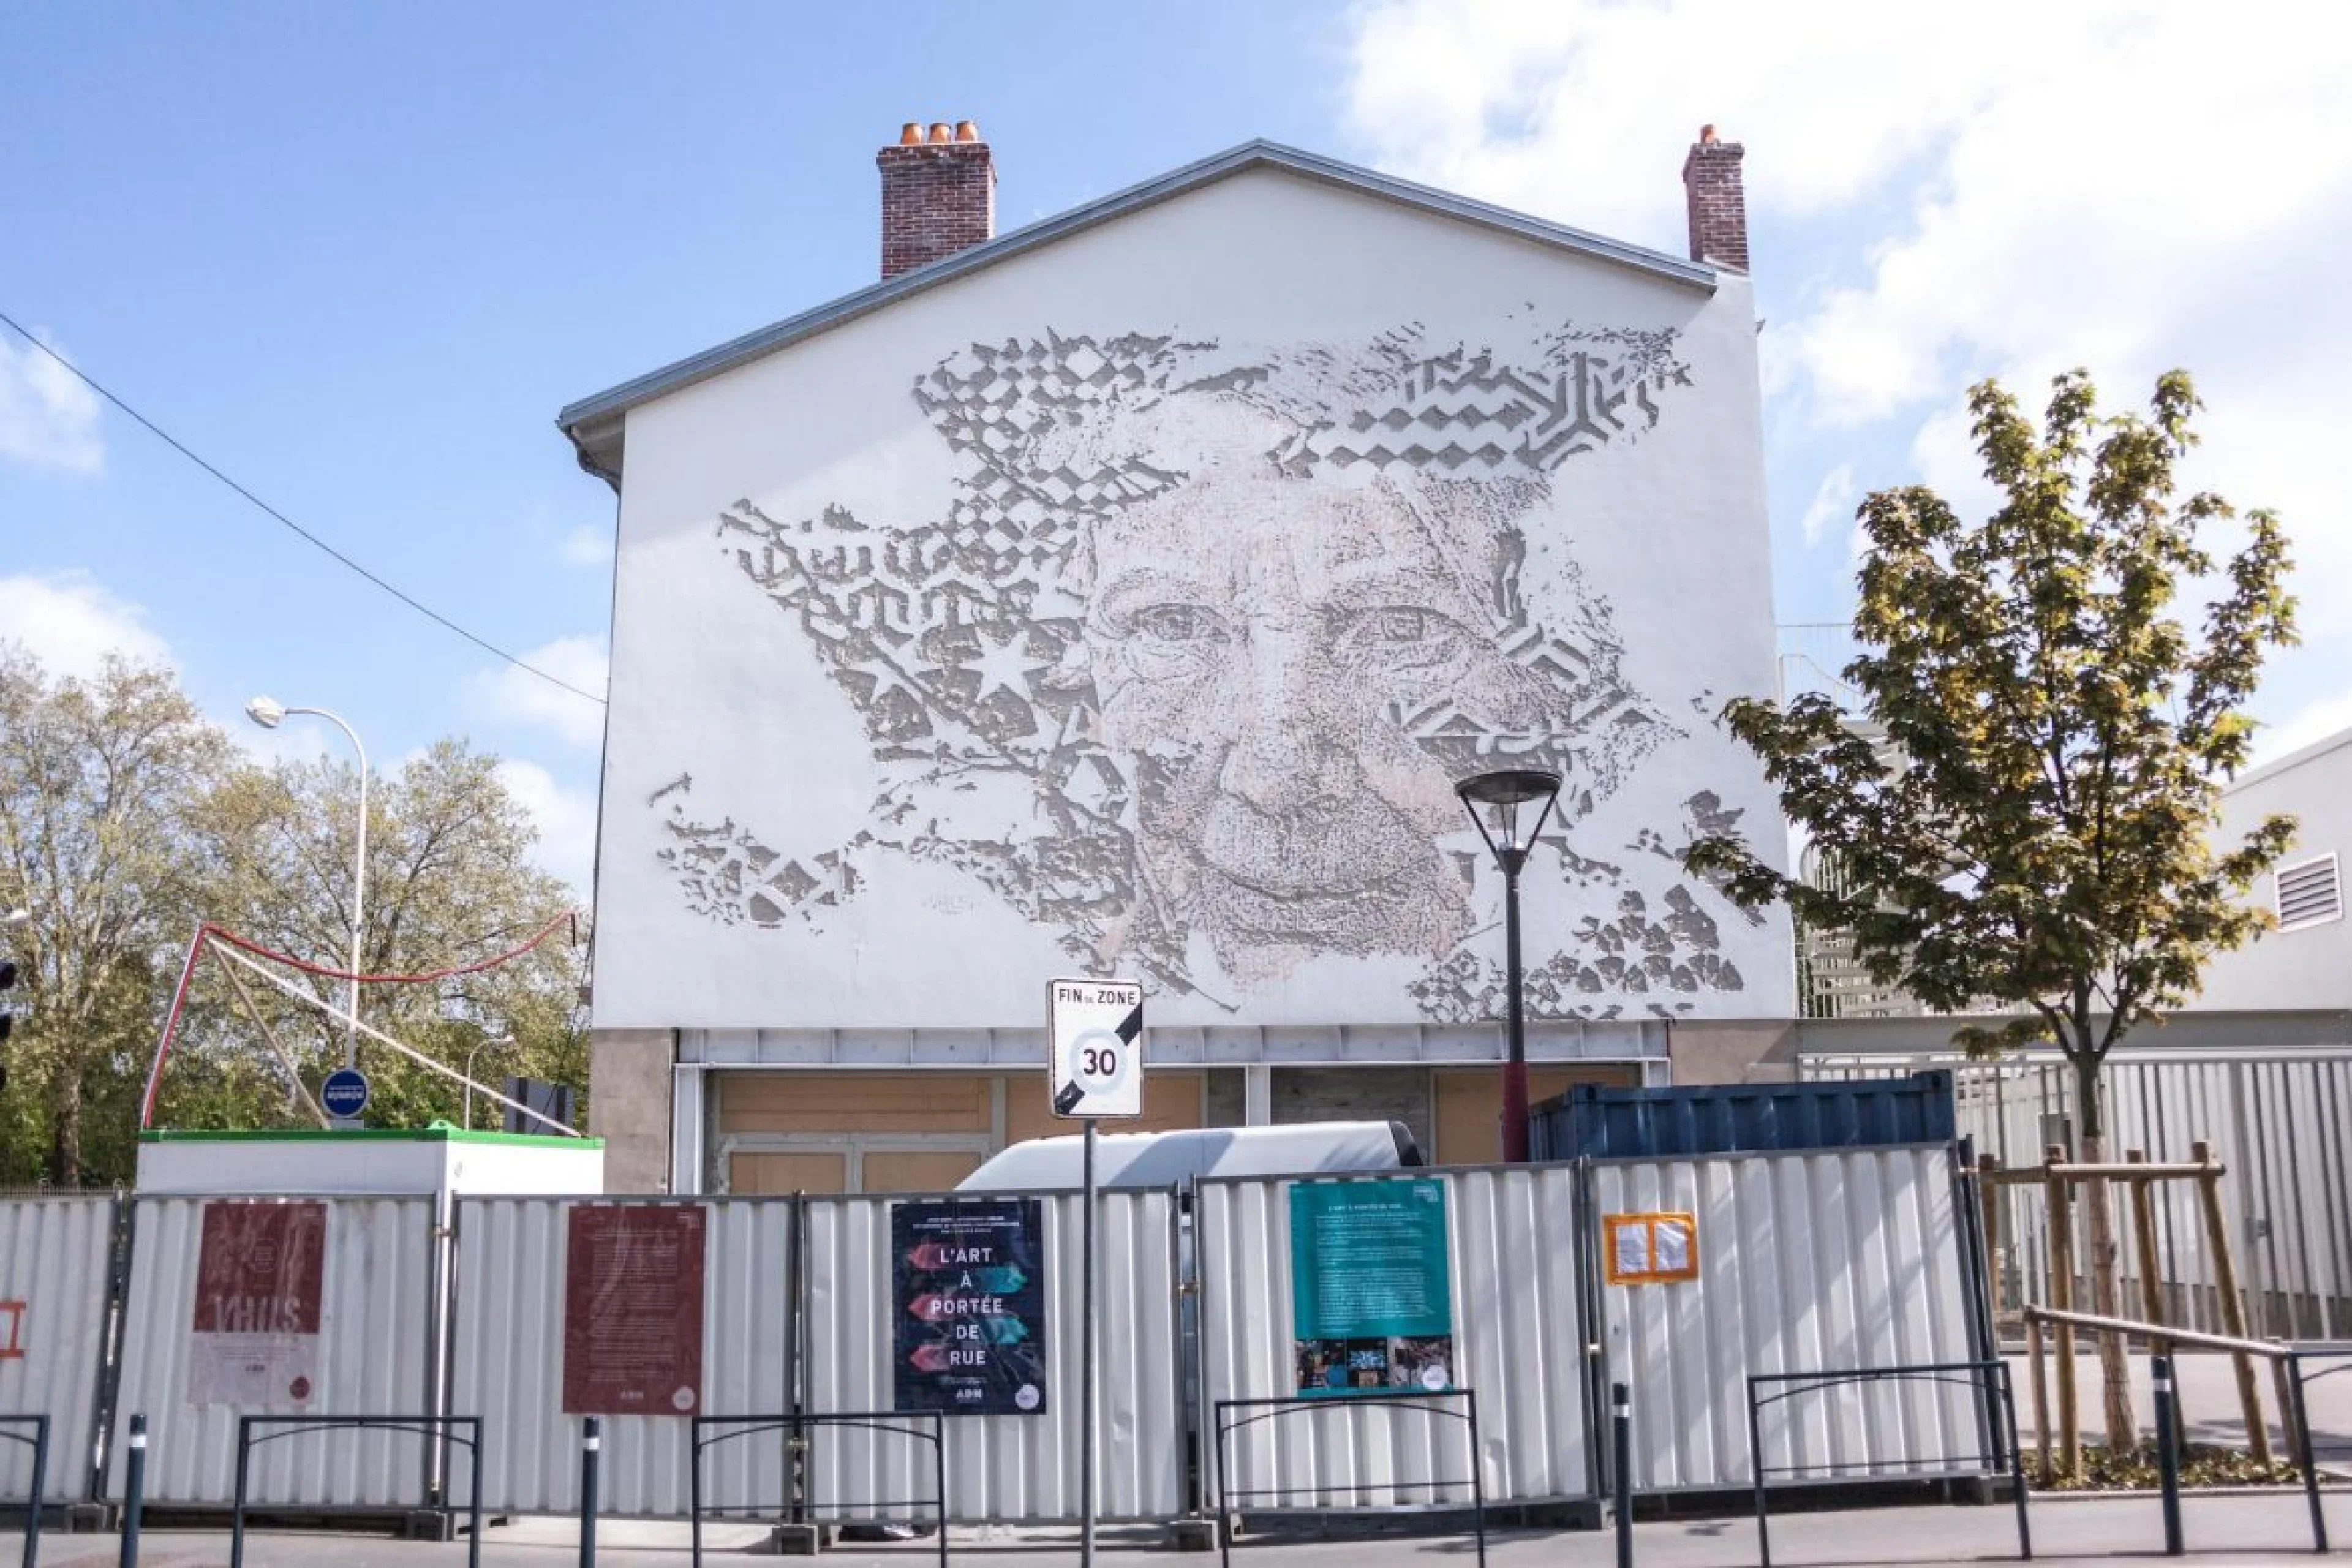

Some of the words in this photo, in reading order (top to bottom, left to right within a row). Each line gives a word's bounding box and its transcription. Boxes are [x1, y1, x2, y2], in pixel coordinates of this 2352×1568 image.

[1058, 989, 1082, 1003] FIN
[1097, 991, 1136, 1006] ZONE
[1083, 1049, 1117, 1076] 30
[940, 1248, 993, 1263] L'ART
[960, 1270, 971, 1287] À
[930, 1295, 1003, 1313] PORTÉE
[956, 1324, 979, 1340] DE
[950, 1350, 986, 1366] RUE
